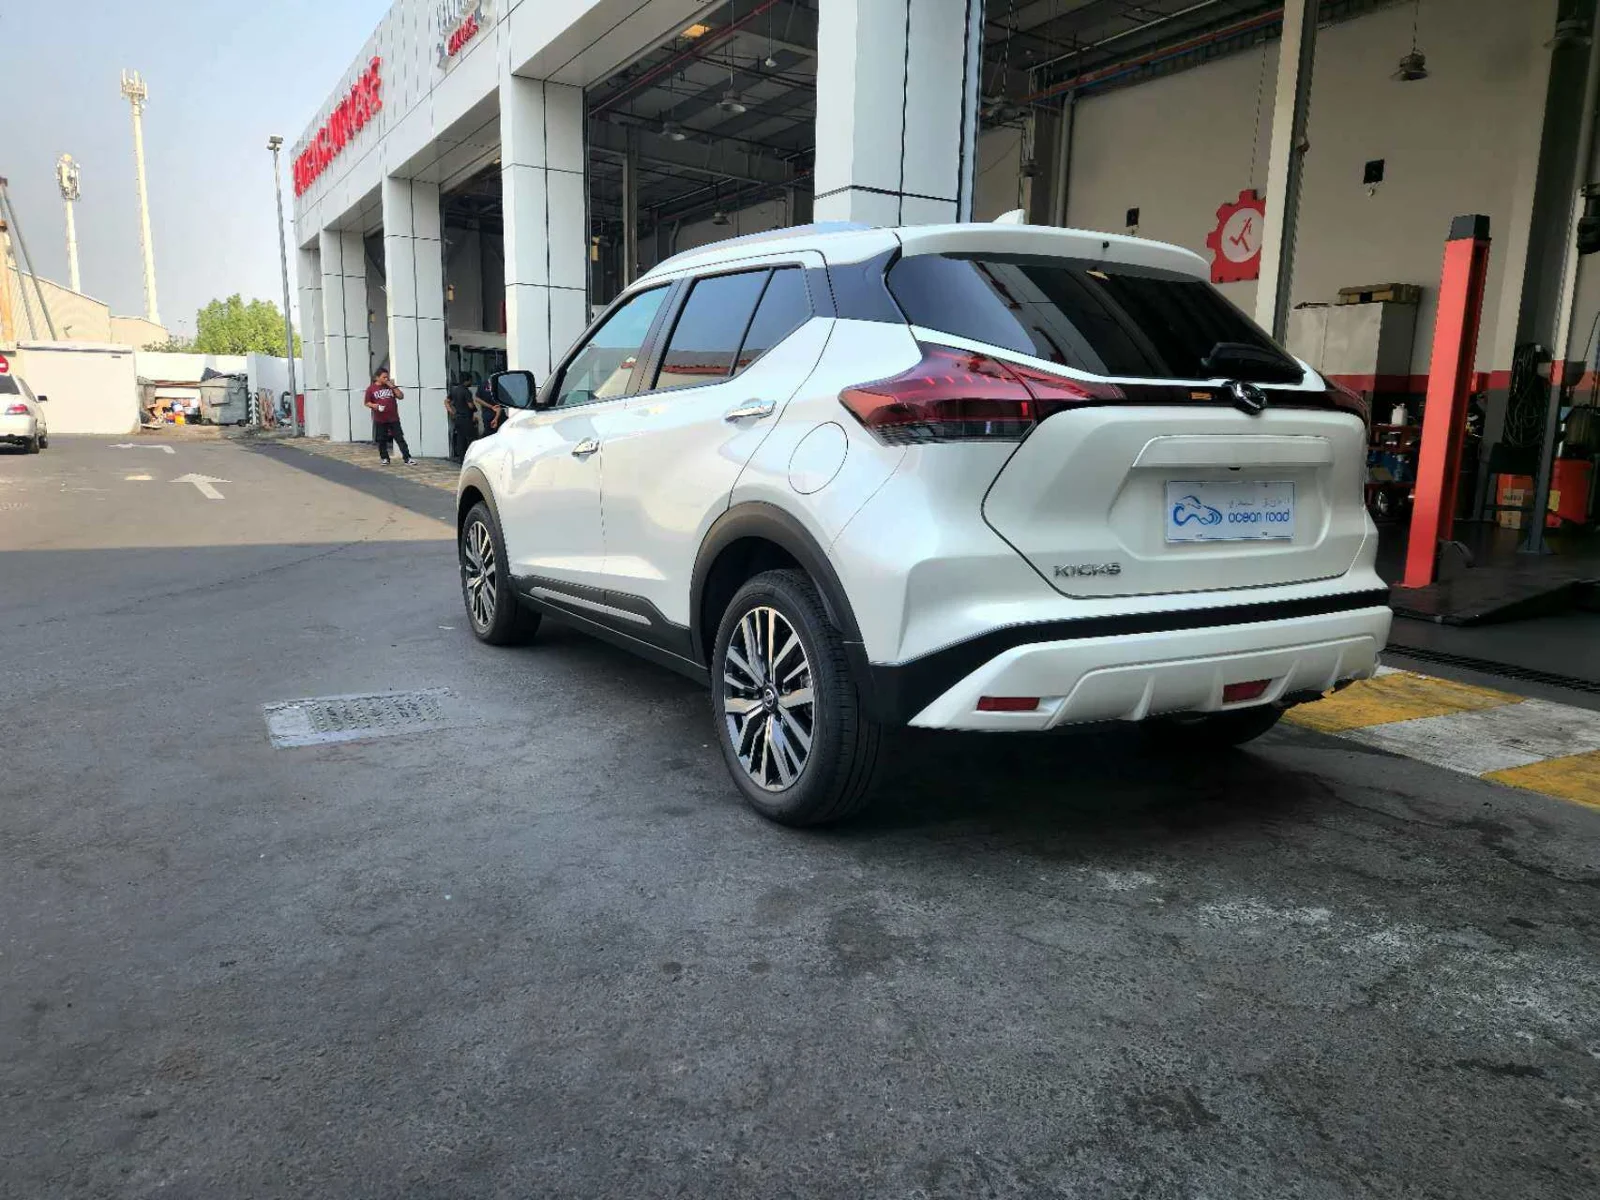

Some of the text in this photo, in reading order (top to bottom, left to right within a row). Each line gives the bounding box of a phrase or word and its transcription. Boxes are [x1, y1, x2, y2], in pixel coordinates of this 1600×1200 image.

[1228, 508, 1290, 523] ocean road
[1053, 563, 1121, 577] KICKS
